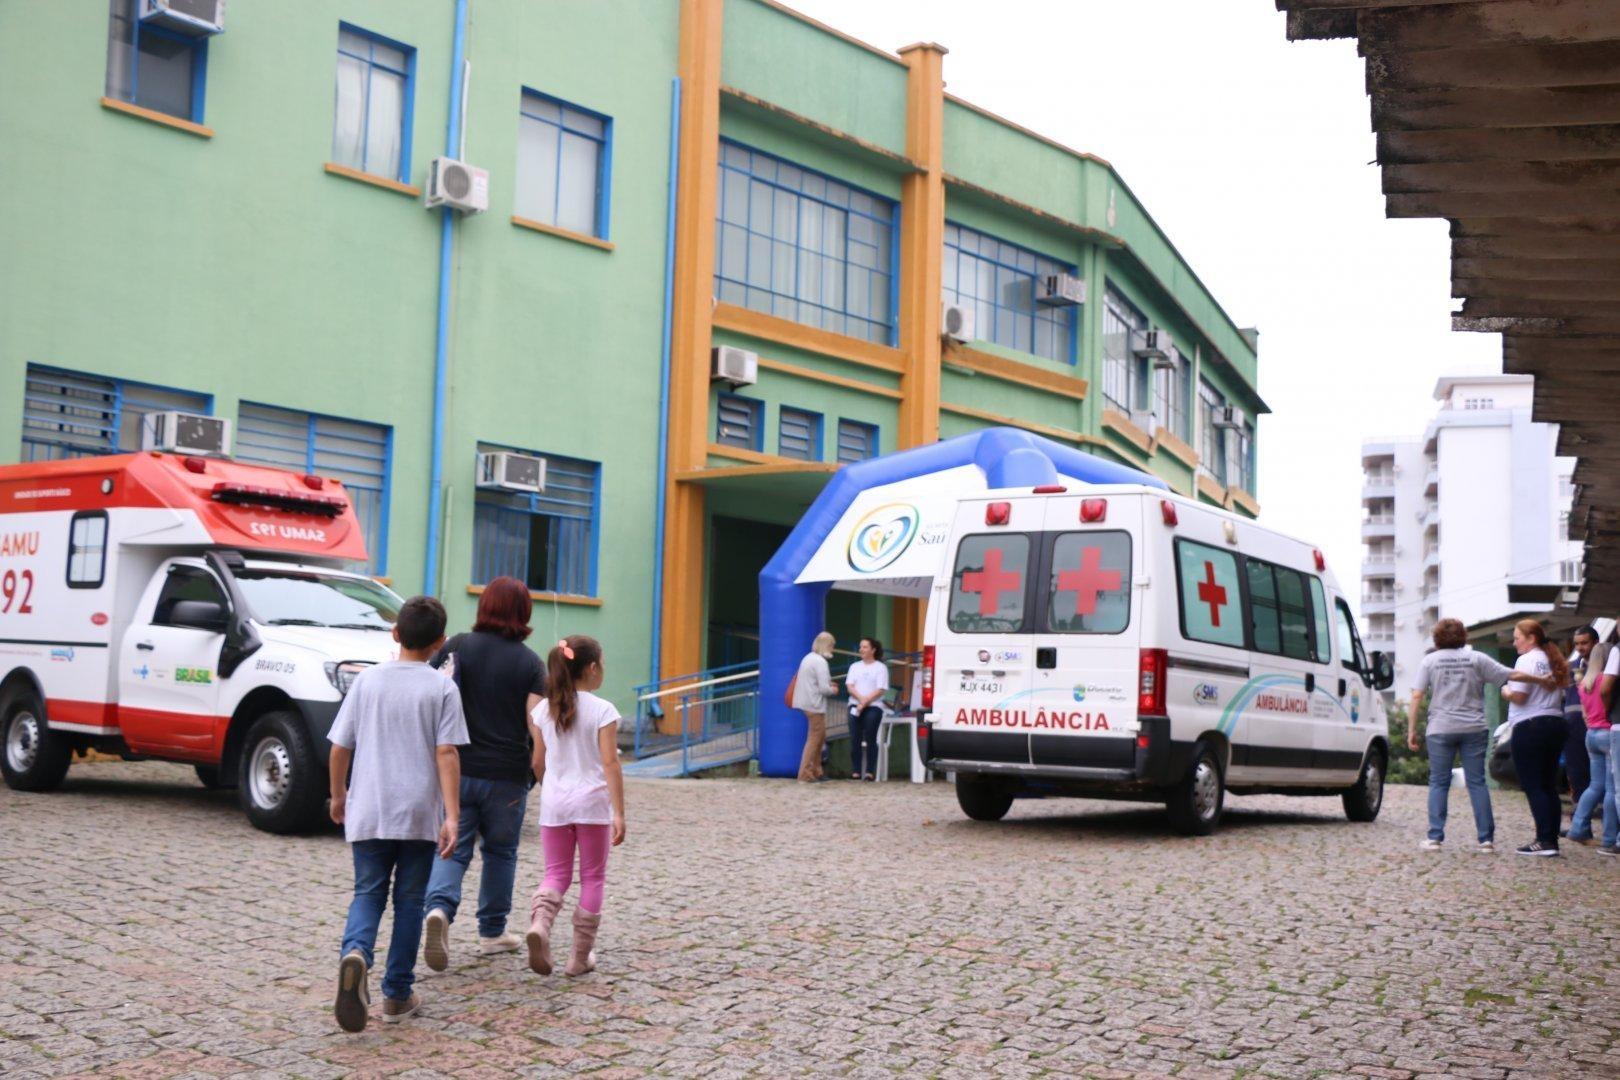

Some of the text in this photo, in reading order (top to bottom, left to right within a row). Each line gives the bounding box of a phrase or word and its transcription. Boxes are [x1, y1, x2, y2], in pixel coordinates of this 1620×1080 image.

[0, 531, 40, 557] AMU
[0, 568, 34, 614] 92
[1255, 693, 1309, 714] AMBULÂNCIA
[955, 706, 1110, 731] AMBULÂNCIA
